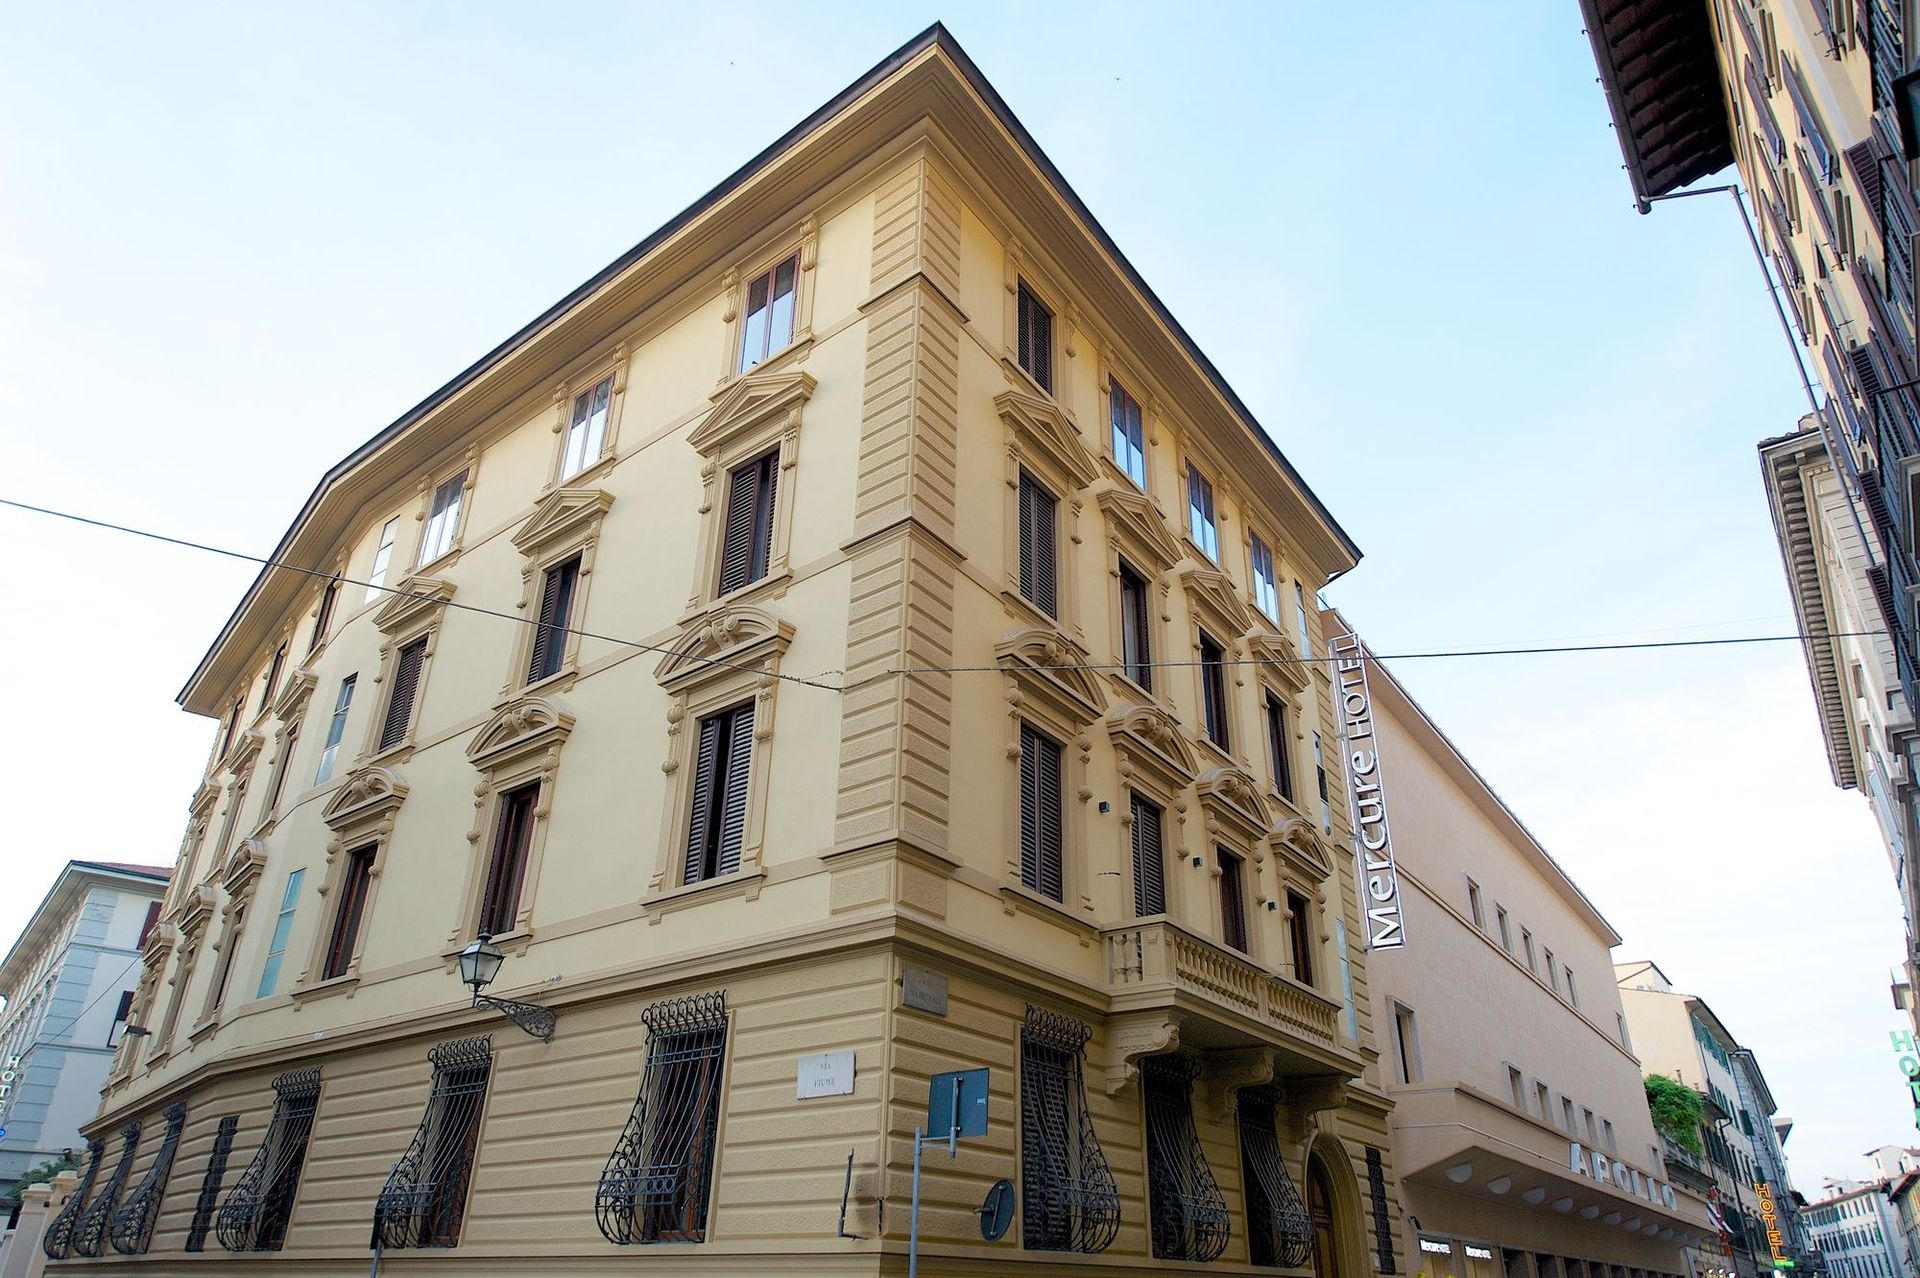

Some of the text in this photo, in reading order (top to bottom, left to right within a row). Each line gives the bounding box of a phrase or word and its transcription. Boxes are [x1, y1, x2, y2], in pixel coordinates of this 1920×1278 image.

[1336, 633, 1401, 949] Mercure HOTEL
[814, 1077, 837, 1088] FIUME
[819, 1062, 832, 1071] VIA
[1571, 1142, 1677, 1211] APOLLO
[1754, 1184, 1787, 1262] HOTEL
